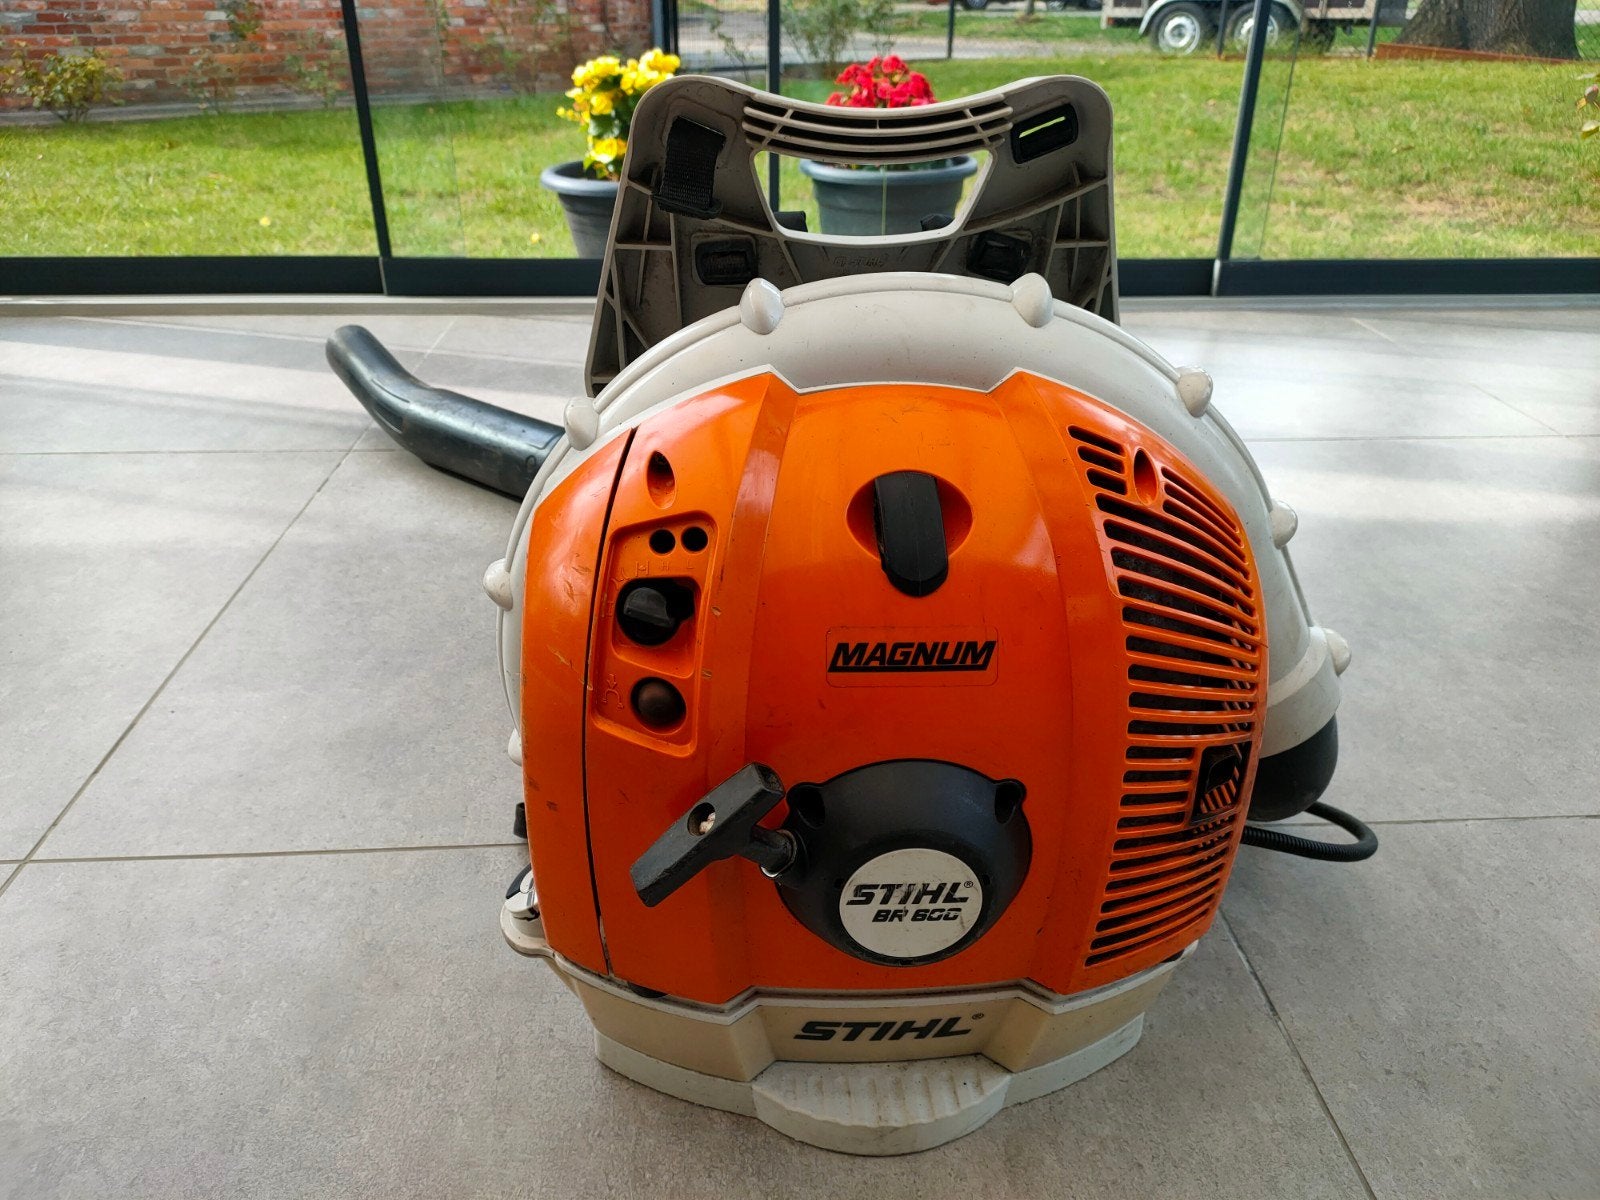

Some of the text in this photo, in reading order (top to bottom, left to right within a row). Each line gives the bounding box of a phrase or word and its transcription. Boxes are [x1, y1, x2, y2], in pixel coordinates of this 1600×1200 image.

[828, 641, 997, 672] MAGNUM
[872, 908, 962, 922] BR 600
